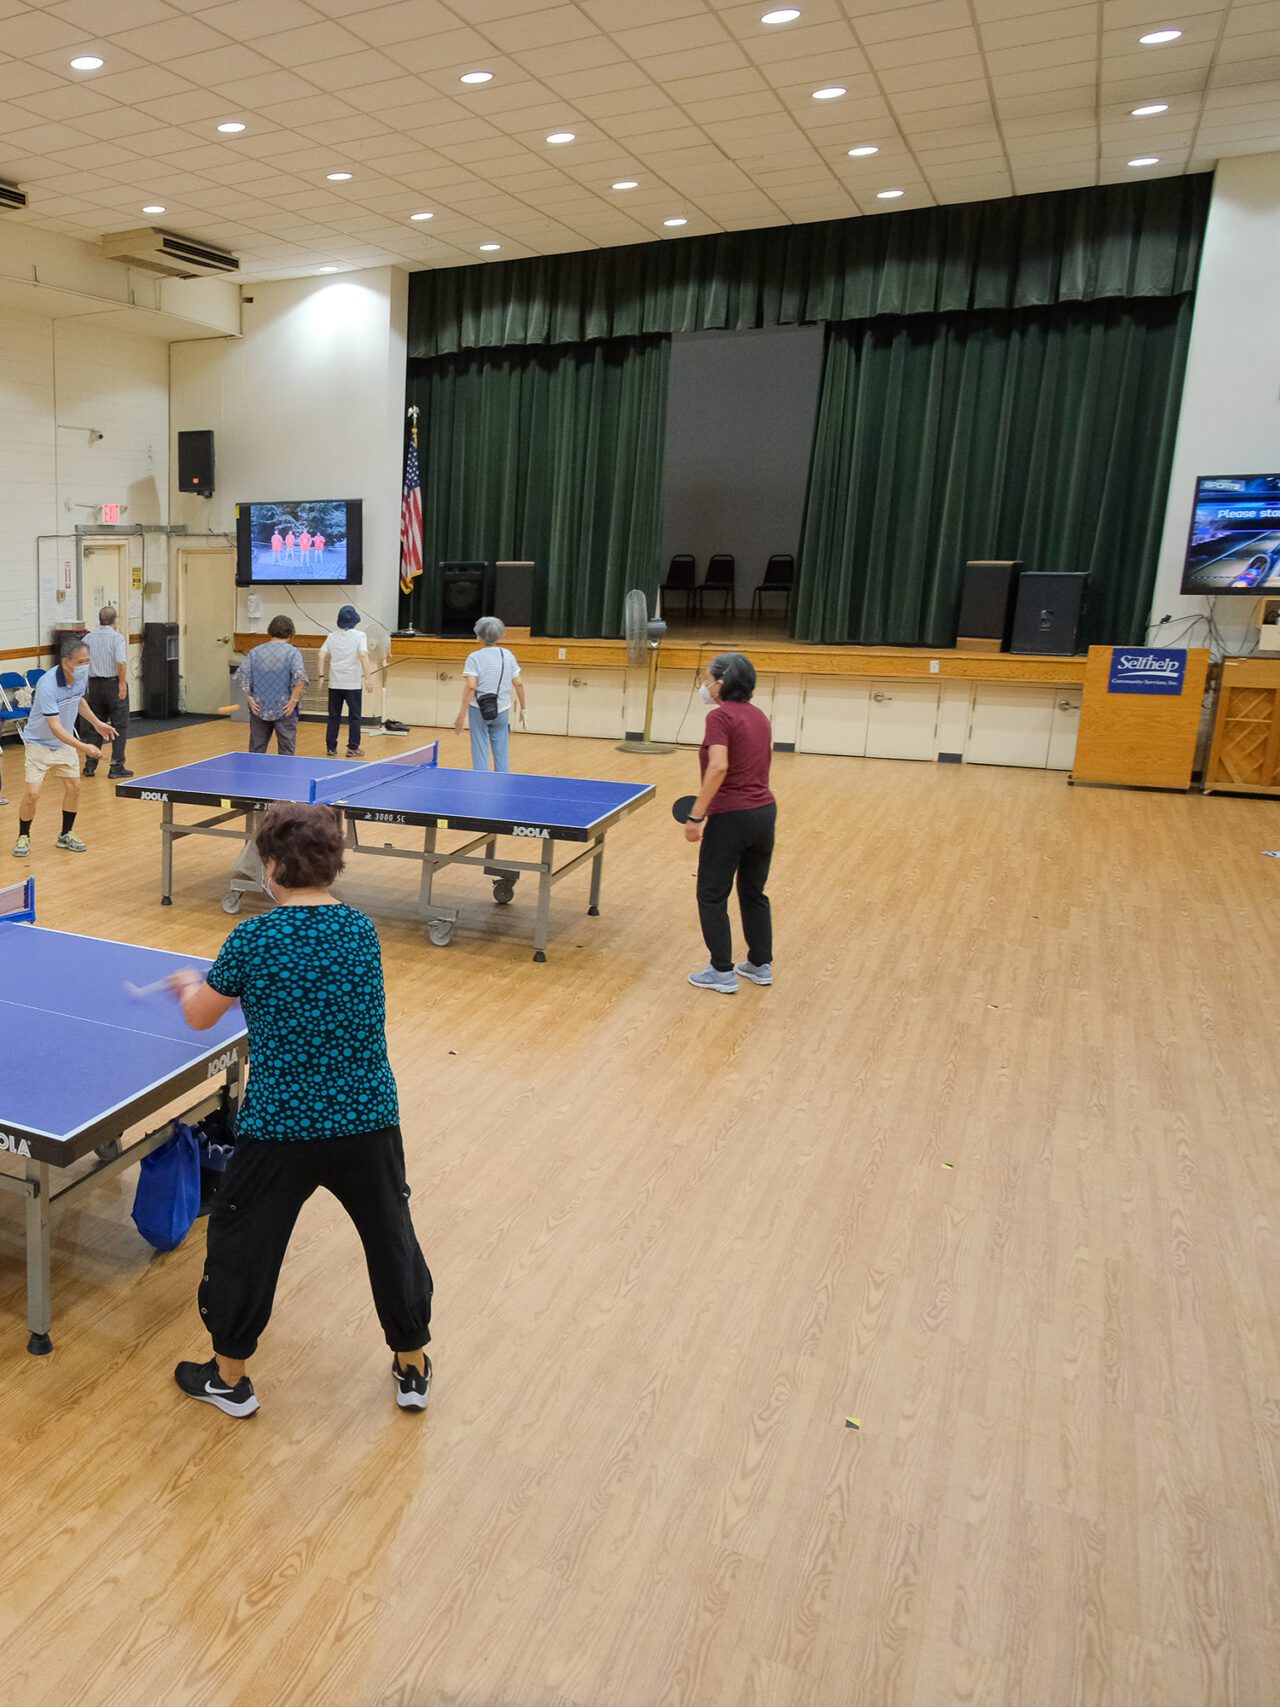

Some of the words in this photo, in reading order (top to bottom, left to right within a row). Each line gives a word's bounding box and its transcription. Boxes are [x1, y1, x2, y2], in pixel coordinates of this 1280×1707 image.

[103, 504, 119, 524] EXIT
[1218, 509, 1257, 518] Please
[1117, 655, 1179, 673] Selfhelp
[141, 791, 168, 802] JOOLA
[375, 812, 393, 822] 3000
[397, 814, 406, 823] SC
[512, 826, 550, 839] JOOLA
[207, 1047, 238, 1078] JOOLA
